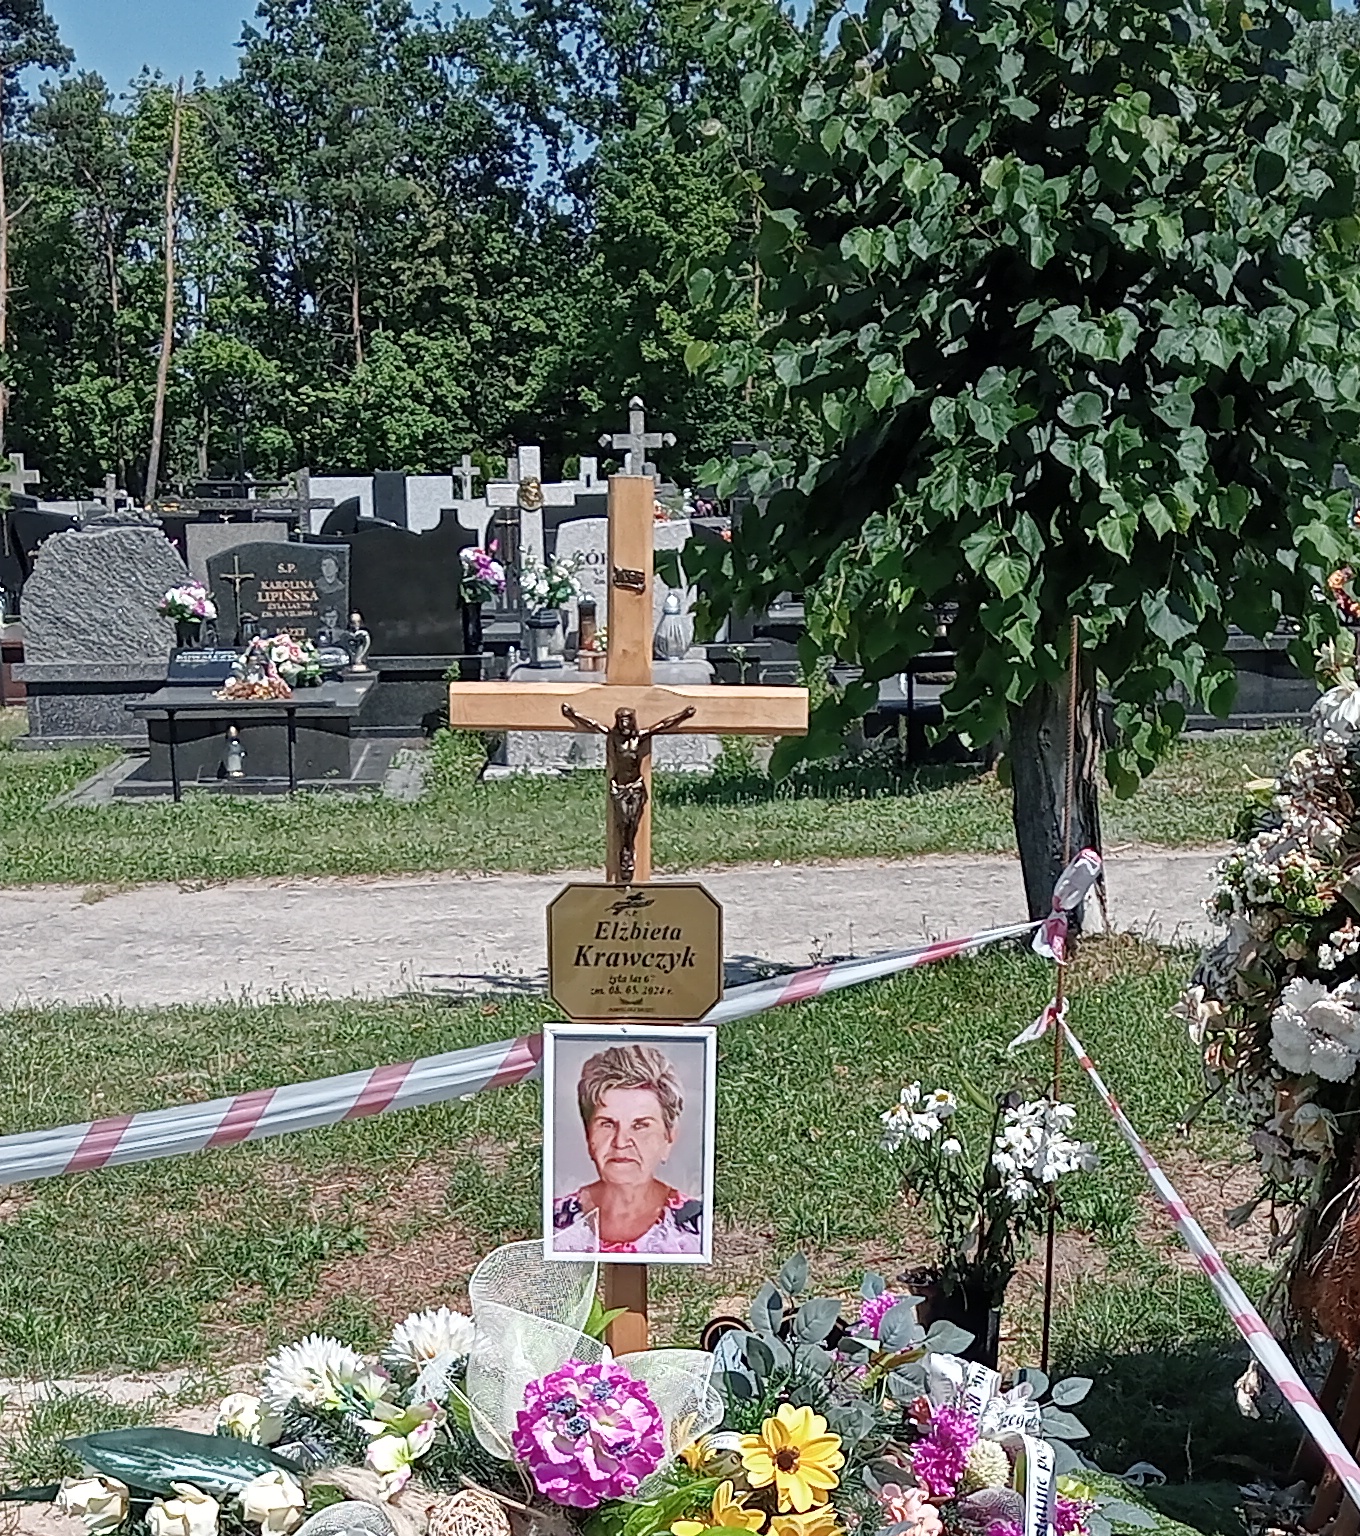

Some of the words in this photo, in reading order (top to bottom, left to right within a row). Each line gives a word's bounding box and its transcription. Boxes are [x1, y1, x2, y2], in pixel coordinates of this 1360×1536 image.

[260, 580, 315, 590] KAROLINA
[256, 589, 320, 603] LIPIŃSKA
[595, 921, 683, 942] Elżbieta
[573, 944, 698, 974] Krawczyk
